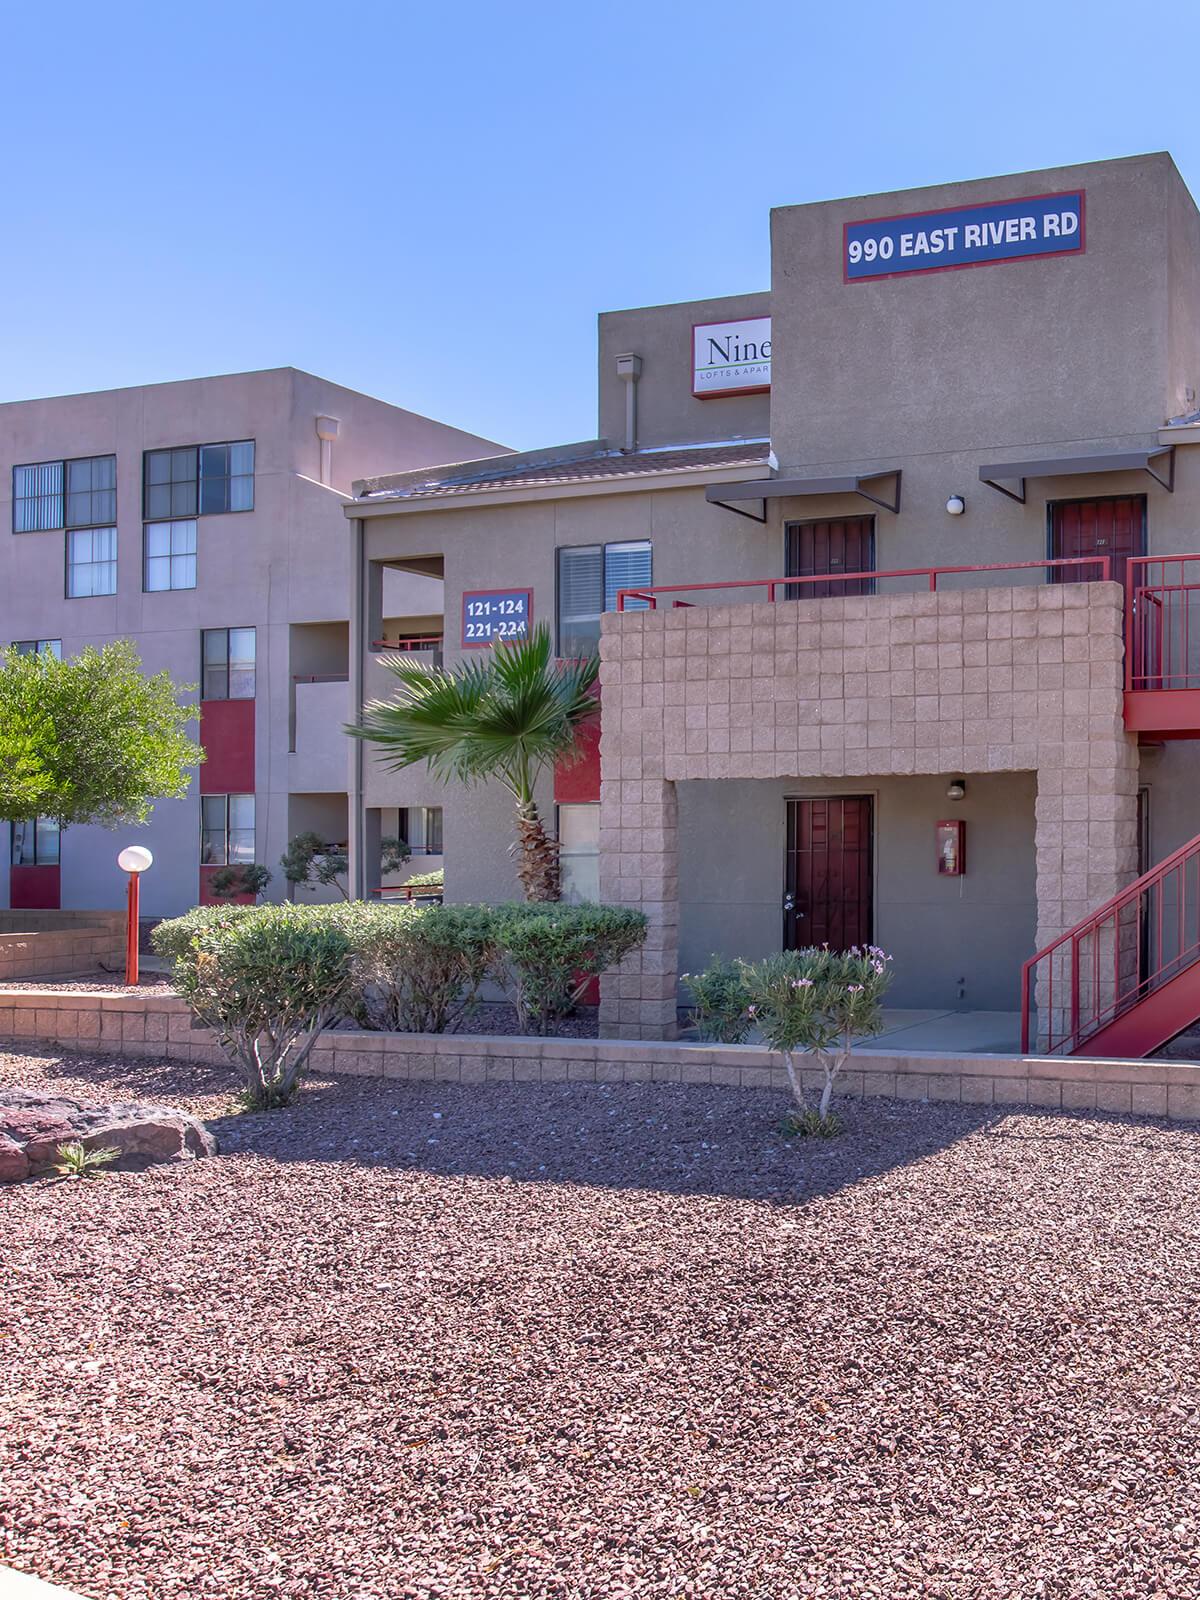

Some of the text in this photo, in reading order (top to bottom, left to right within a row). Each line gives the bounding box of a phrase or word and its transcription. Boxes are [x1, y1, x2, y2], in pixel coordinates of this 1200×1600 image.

[848, 211, 1078, 264] 990 EAST RIVER RD
[707, 335, 772, 365] Nine
[700, 369, 731, 380] LOFTS
[743, 365, 769, 375] APAR
[467, 599, 524, 617] 121-124
[466, 620, 526, 638] 221-224
